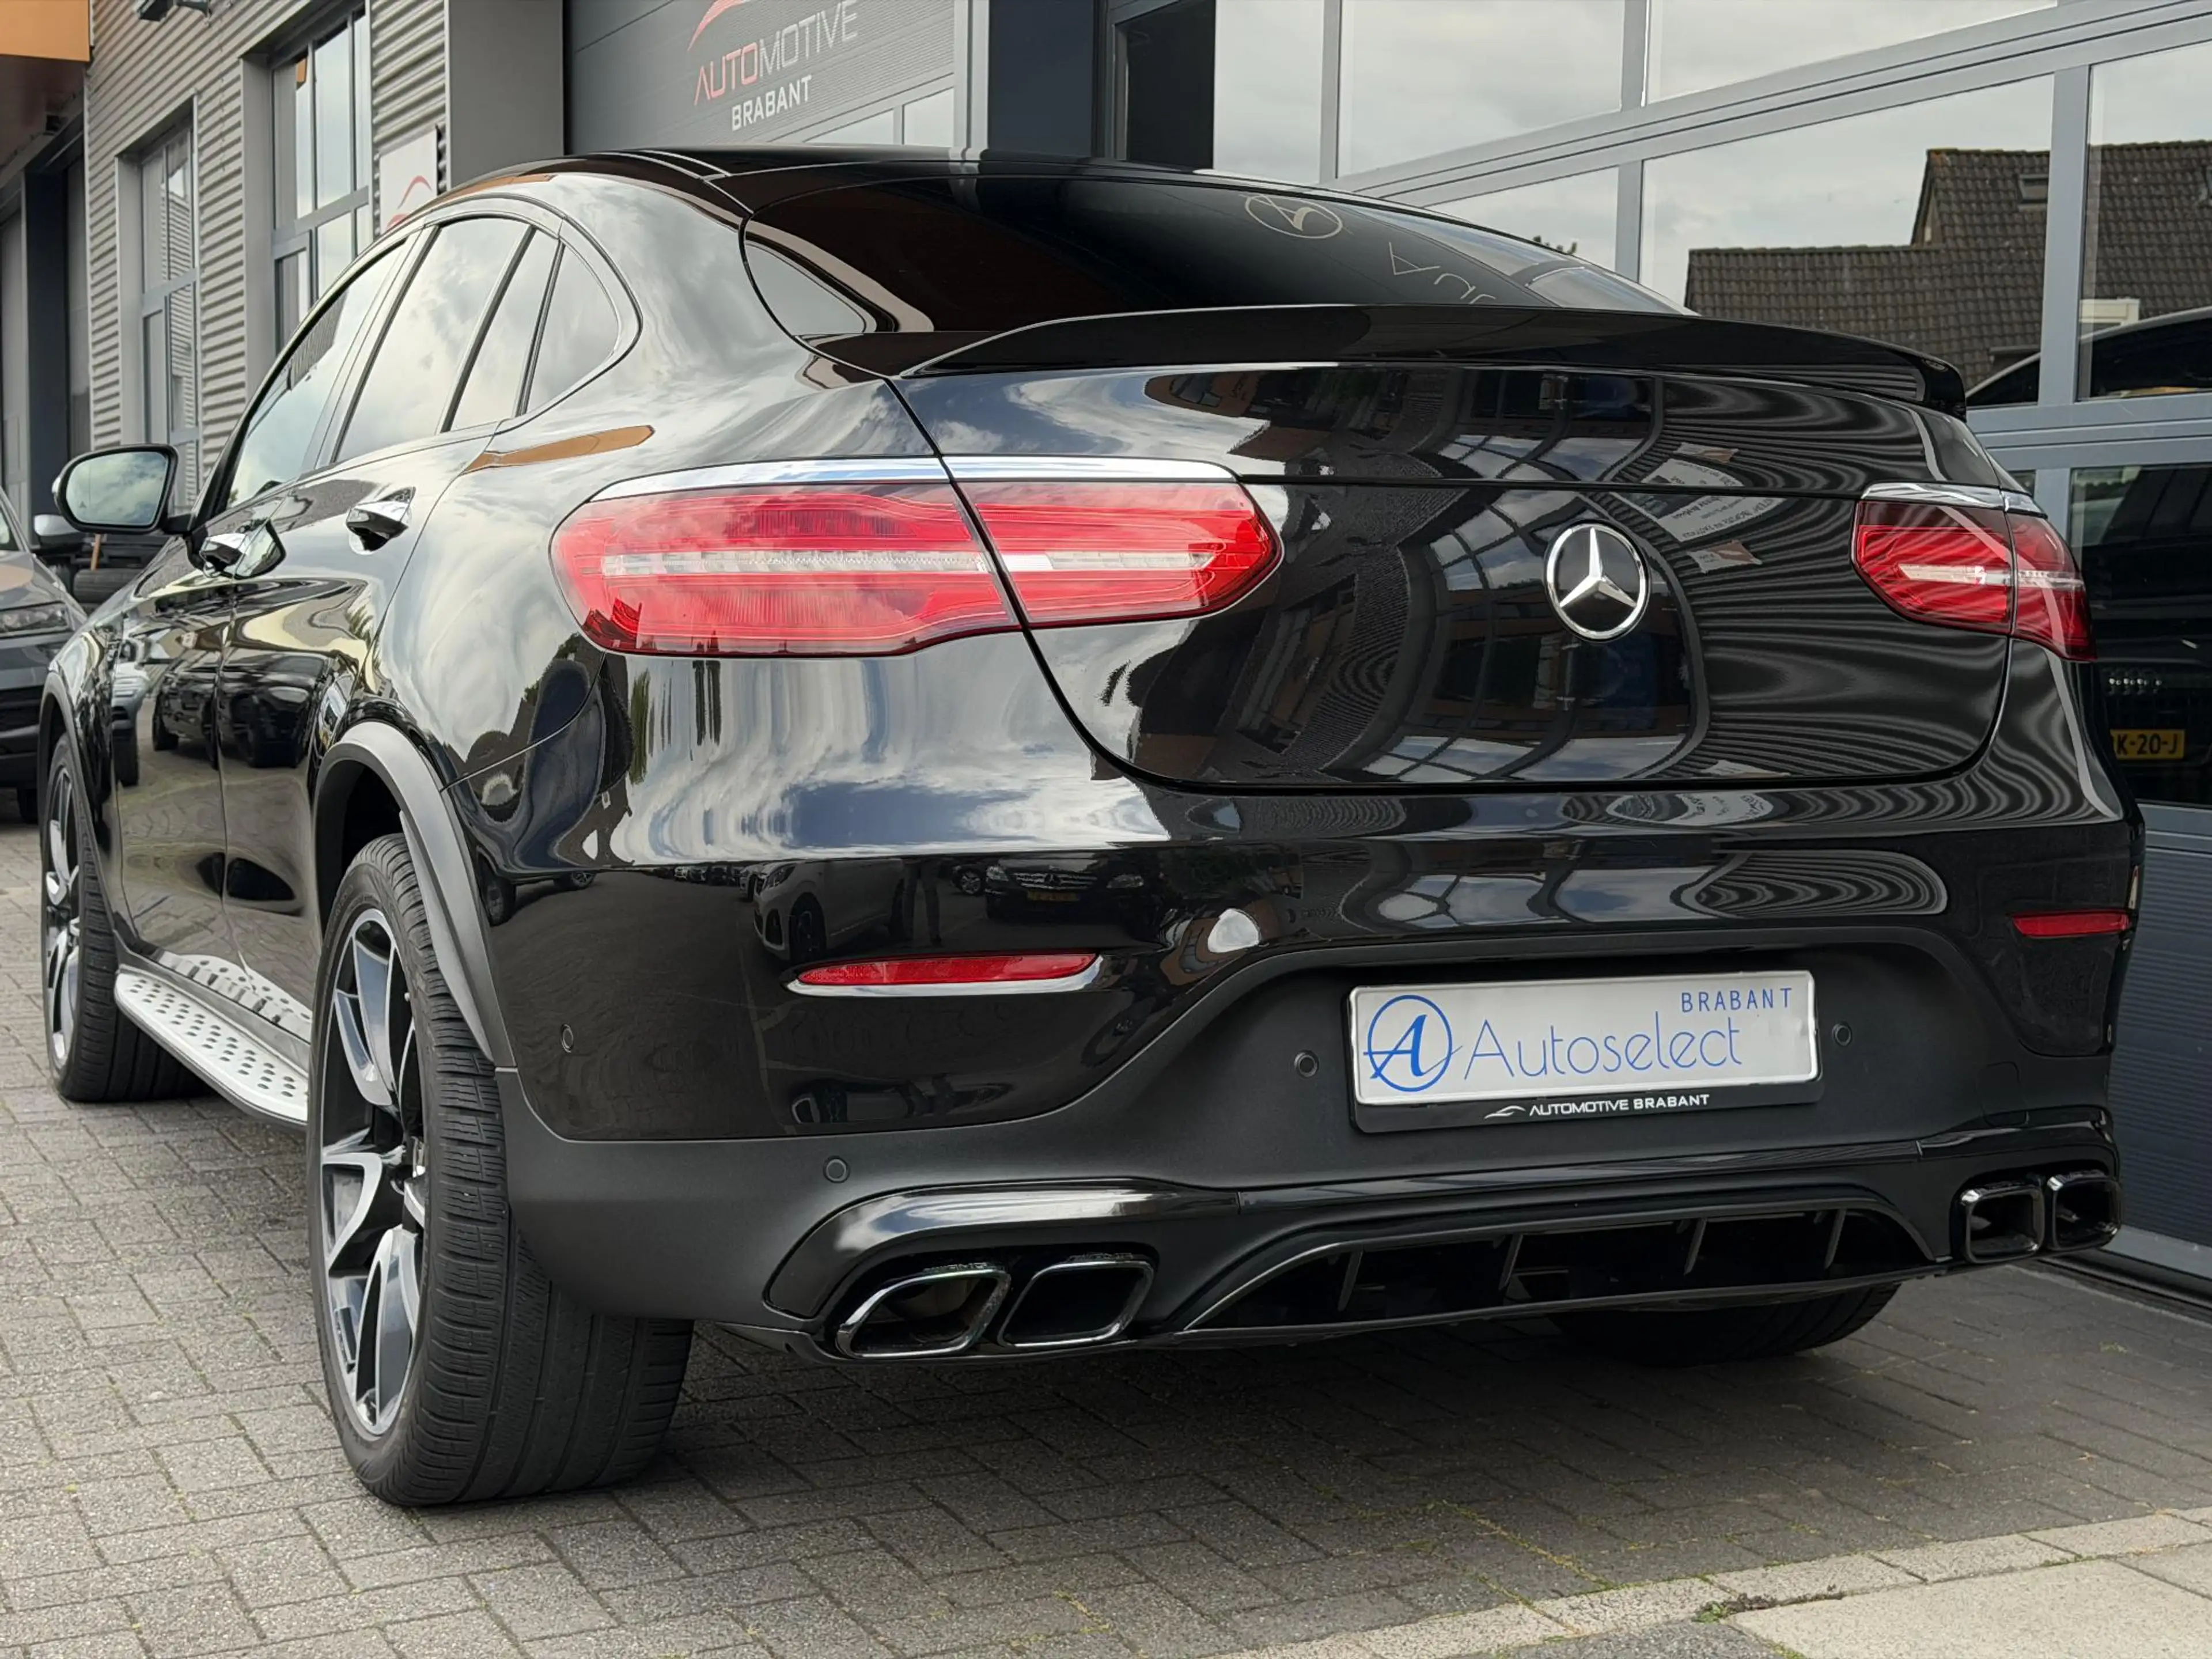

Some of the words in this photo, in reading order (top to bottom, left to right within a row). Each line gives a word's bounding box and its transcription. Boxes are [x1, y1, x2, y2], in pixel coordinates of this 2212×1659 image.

[694, 0, 858, 105] AUTOMOTIVE
[732, 75, 812, 131] BRABANT
[2111, 733, 2179, 755] K-20-J
[1681, 987, 1793, 1012] BRABANT
[1464, 1010, 1742, 1080] Autoselect
[1529, 1099, 1628, 1116] AUTOMOTIVE
[1634, 1094, 1710, 1109] BRABANT
